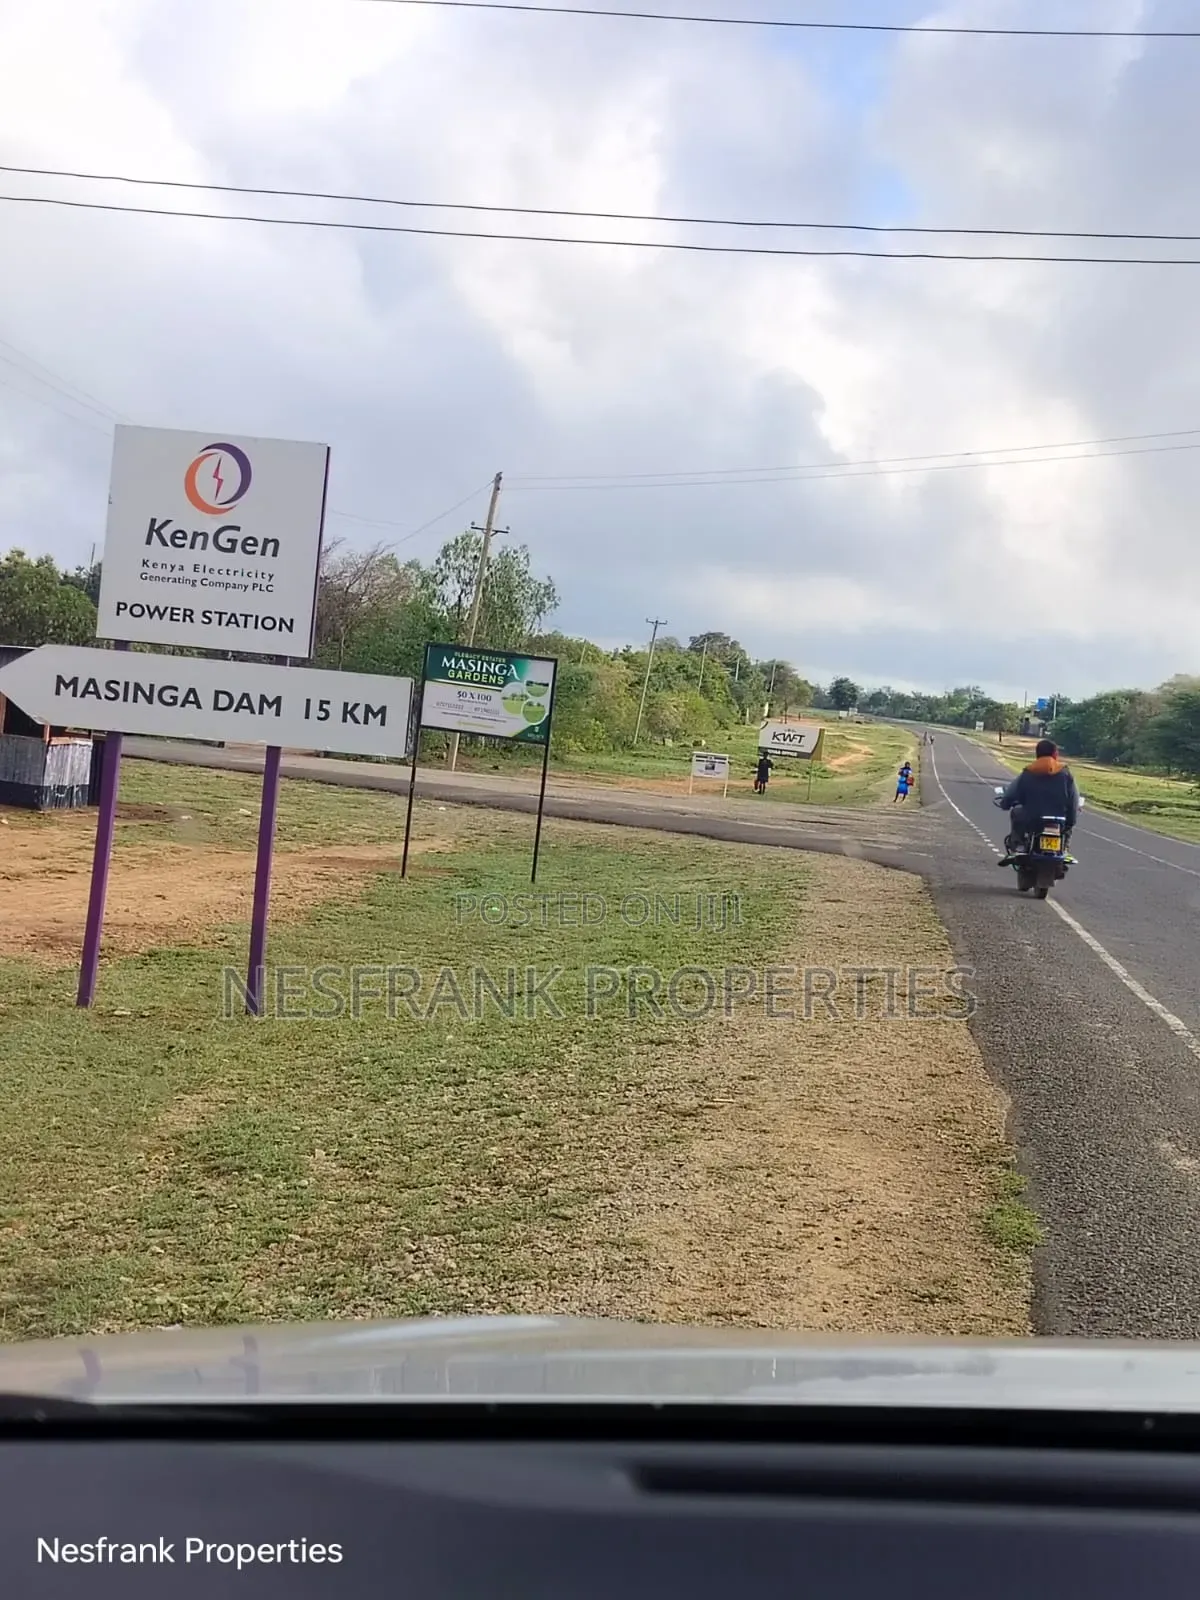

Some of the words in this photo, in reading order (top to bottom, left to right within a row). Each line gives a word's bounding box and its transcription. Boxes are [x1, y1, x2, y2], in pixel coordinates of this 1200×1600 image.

[145, 517, 280, 558] KenGen
[142, 559, 185, 573] Kenya
[193, 564, 275, 582] Electricity
[140, 572, 197, 588] Generating
[200, 577, 249, 592] Company
[252, 582, 274, 593] PLC
[116, 601, 194, 624] POWER
[201, 609, 294, 634] STATION
[441, 656, 520, 680] MASINGA
[448, 669, 504, 684] GARDENS
[54, 673, 202, 711] MASINGA
[213, 688, 282, 718] DAM
[304, 697, 331, 722] 15
[341, 701, 388, 728] KM
[457, 690, 467, 699] 50
[476, 693, 492, 702] 100
[771, 731, 806, 744] KWFT
